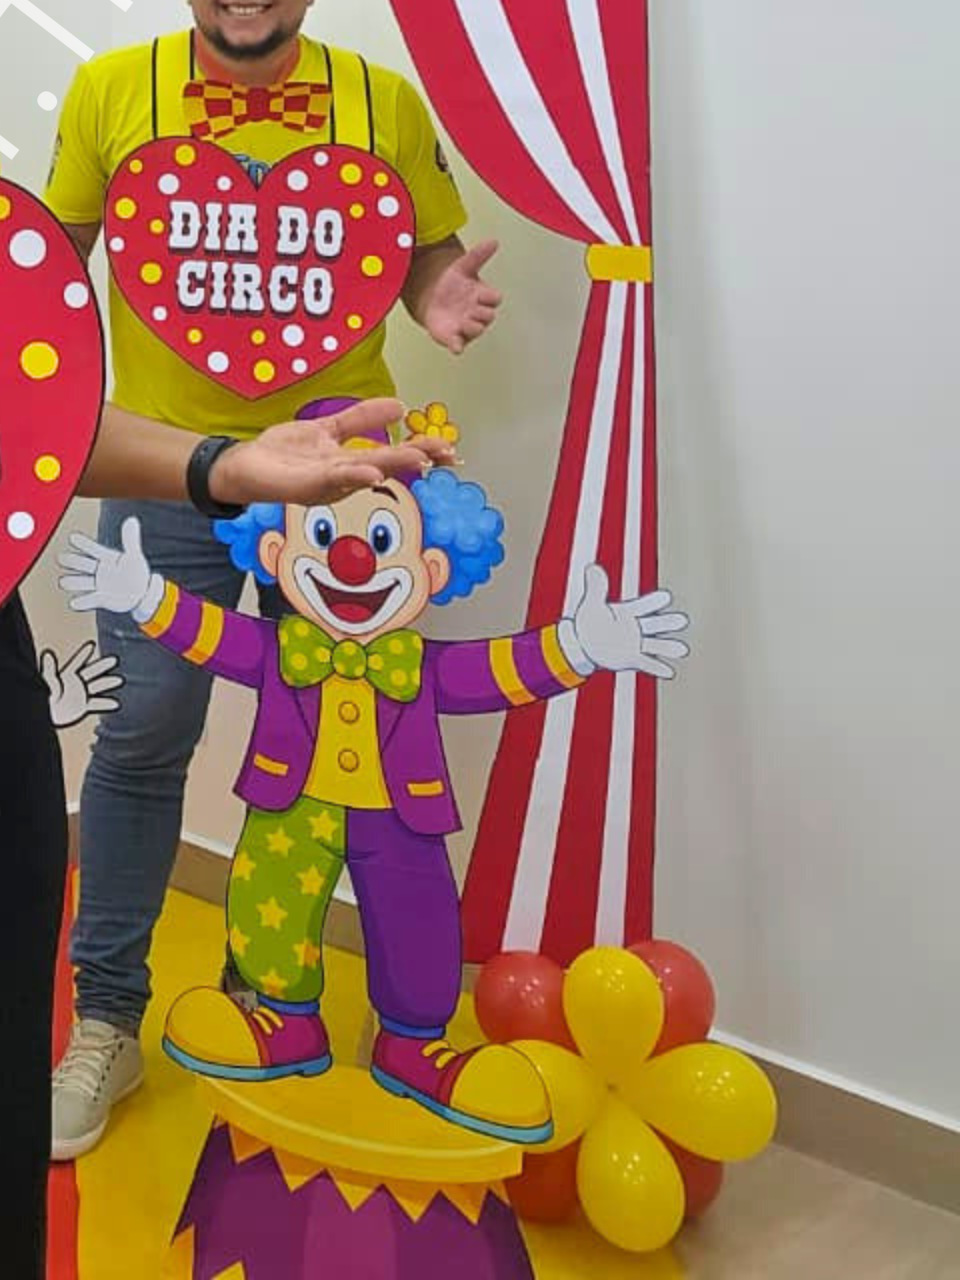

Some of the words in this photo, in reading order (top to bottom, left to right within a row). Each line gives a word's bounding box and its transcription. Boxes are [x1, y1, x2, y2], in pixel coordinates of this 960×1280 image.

[168, 200, 259, 255] DIA
[276, 205, 343, 258] DO
[176, 260, 334, 317] CIRCO
